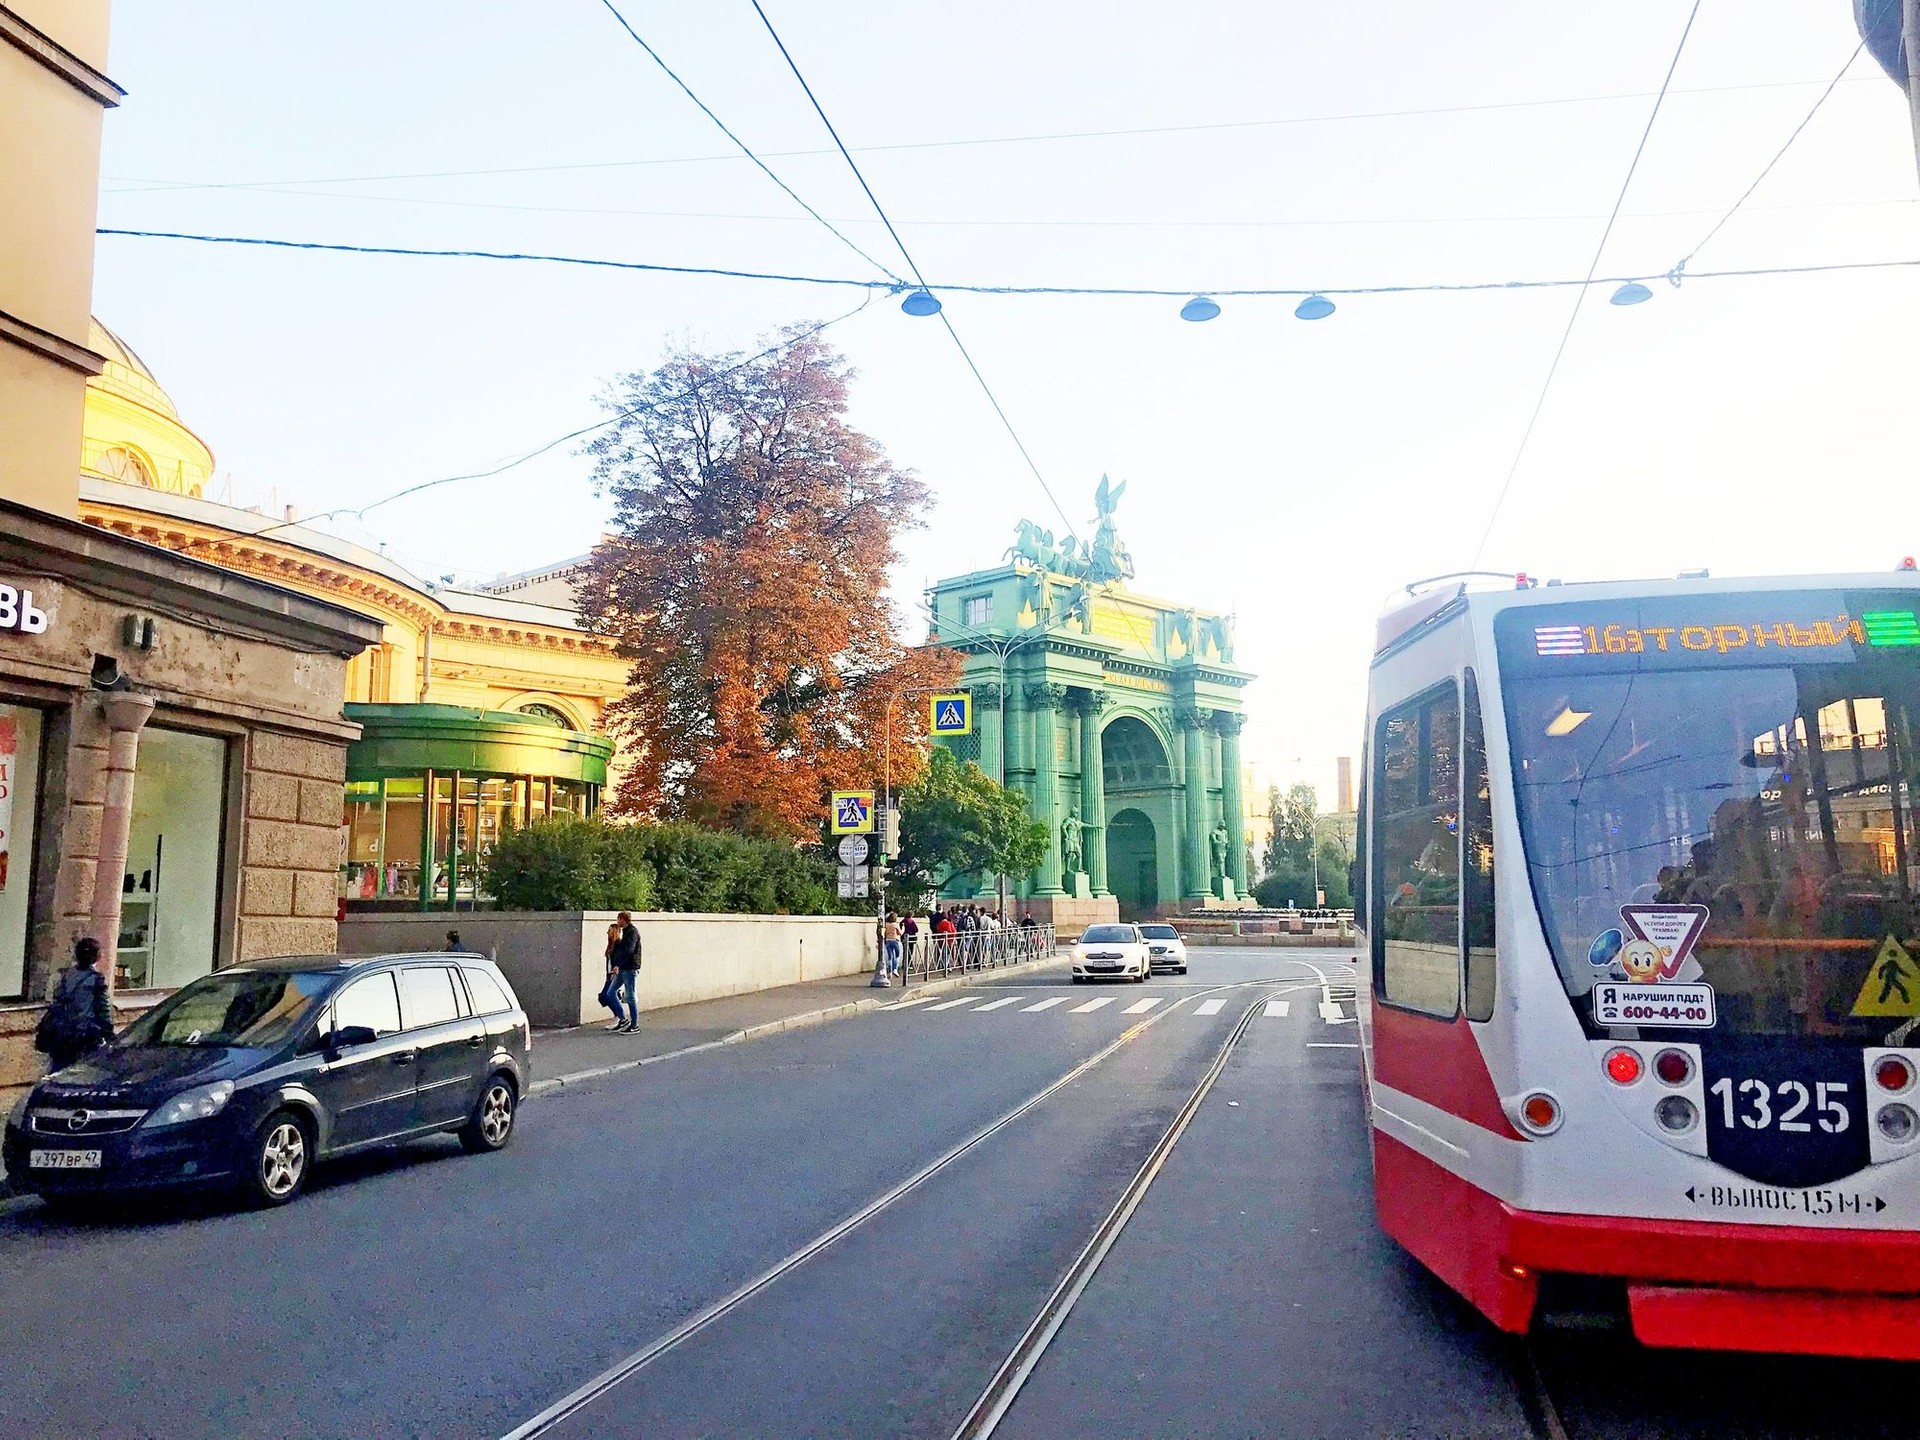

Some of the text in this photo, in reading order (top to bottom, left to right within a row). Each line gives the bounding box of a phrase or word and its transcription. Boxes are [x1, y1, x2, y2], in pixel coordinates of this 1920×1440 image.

[1603, 988, 1705, 1005] Я НАРУШИЛ ПДД?
[1623, 1006, 1706, 1019] 600-44-00
[1710, 1077, 1850, 1134] 1325
[1711, 1186, 1796, 1211] ВЫНОС
[1839, 1192, 1860, 1214] М
